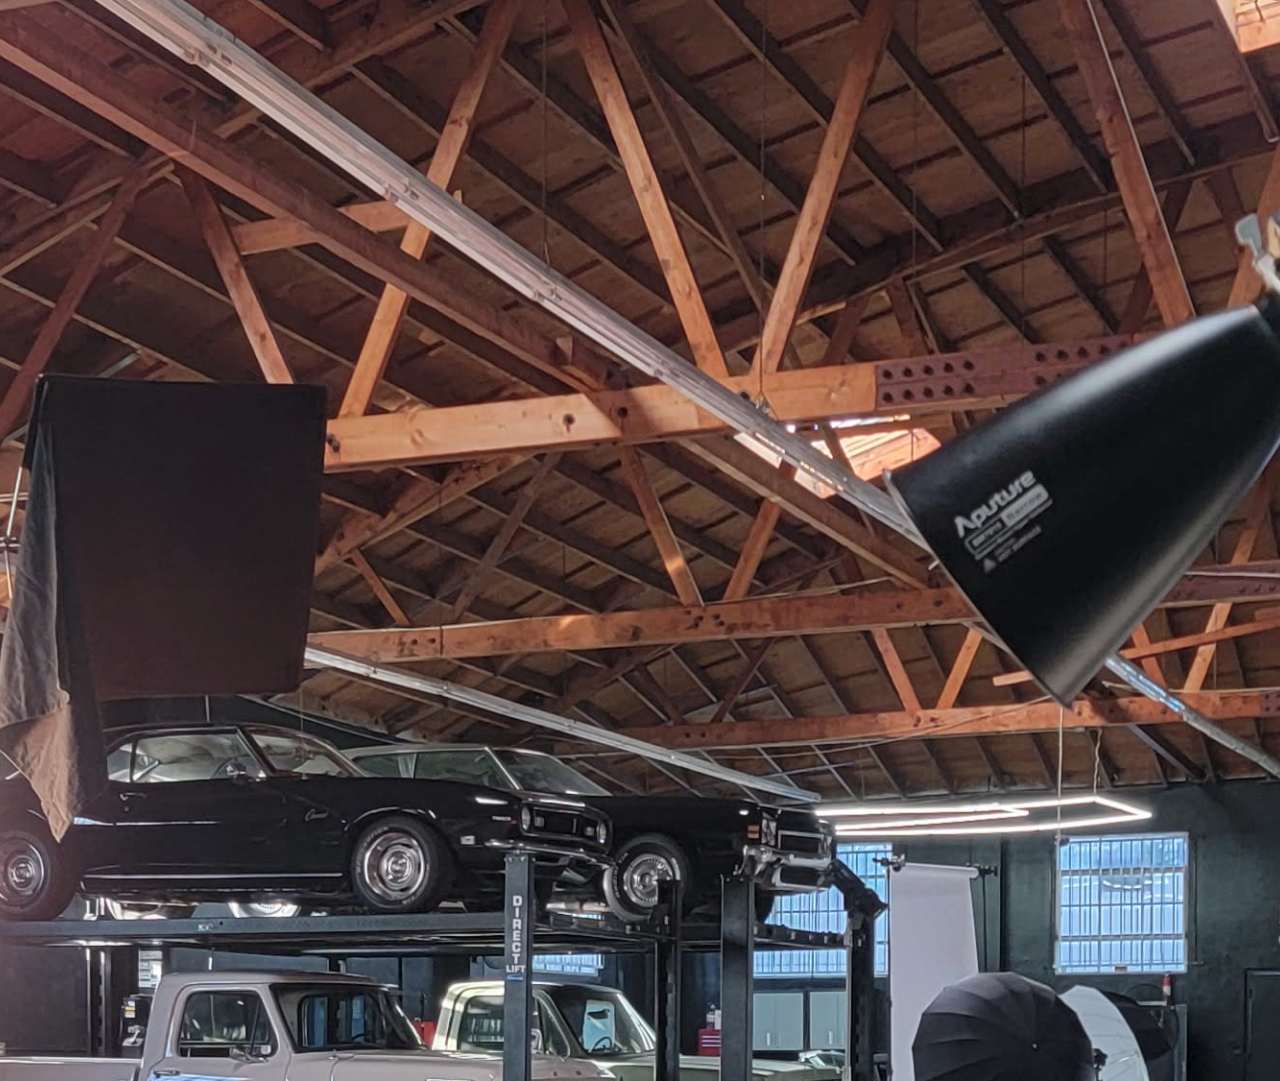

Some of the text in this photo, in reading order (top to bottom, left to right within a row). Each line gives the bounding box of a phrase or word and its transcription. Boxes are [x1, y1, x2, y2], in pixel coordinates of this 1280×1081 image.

[954, 469, 1037, 539] Aputure
[511, 895, 523, 964] DIRECT
[505, 965, 526, 973] LIFT
